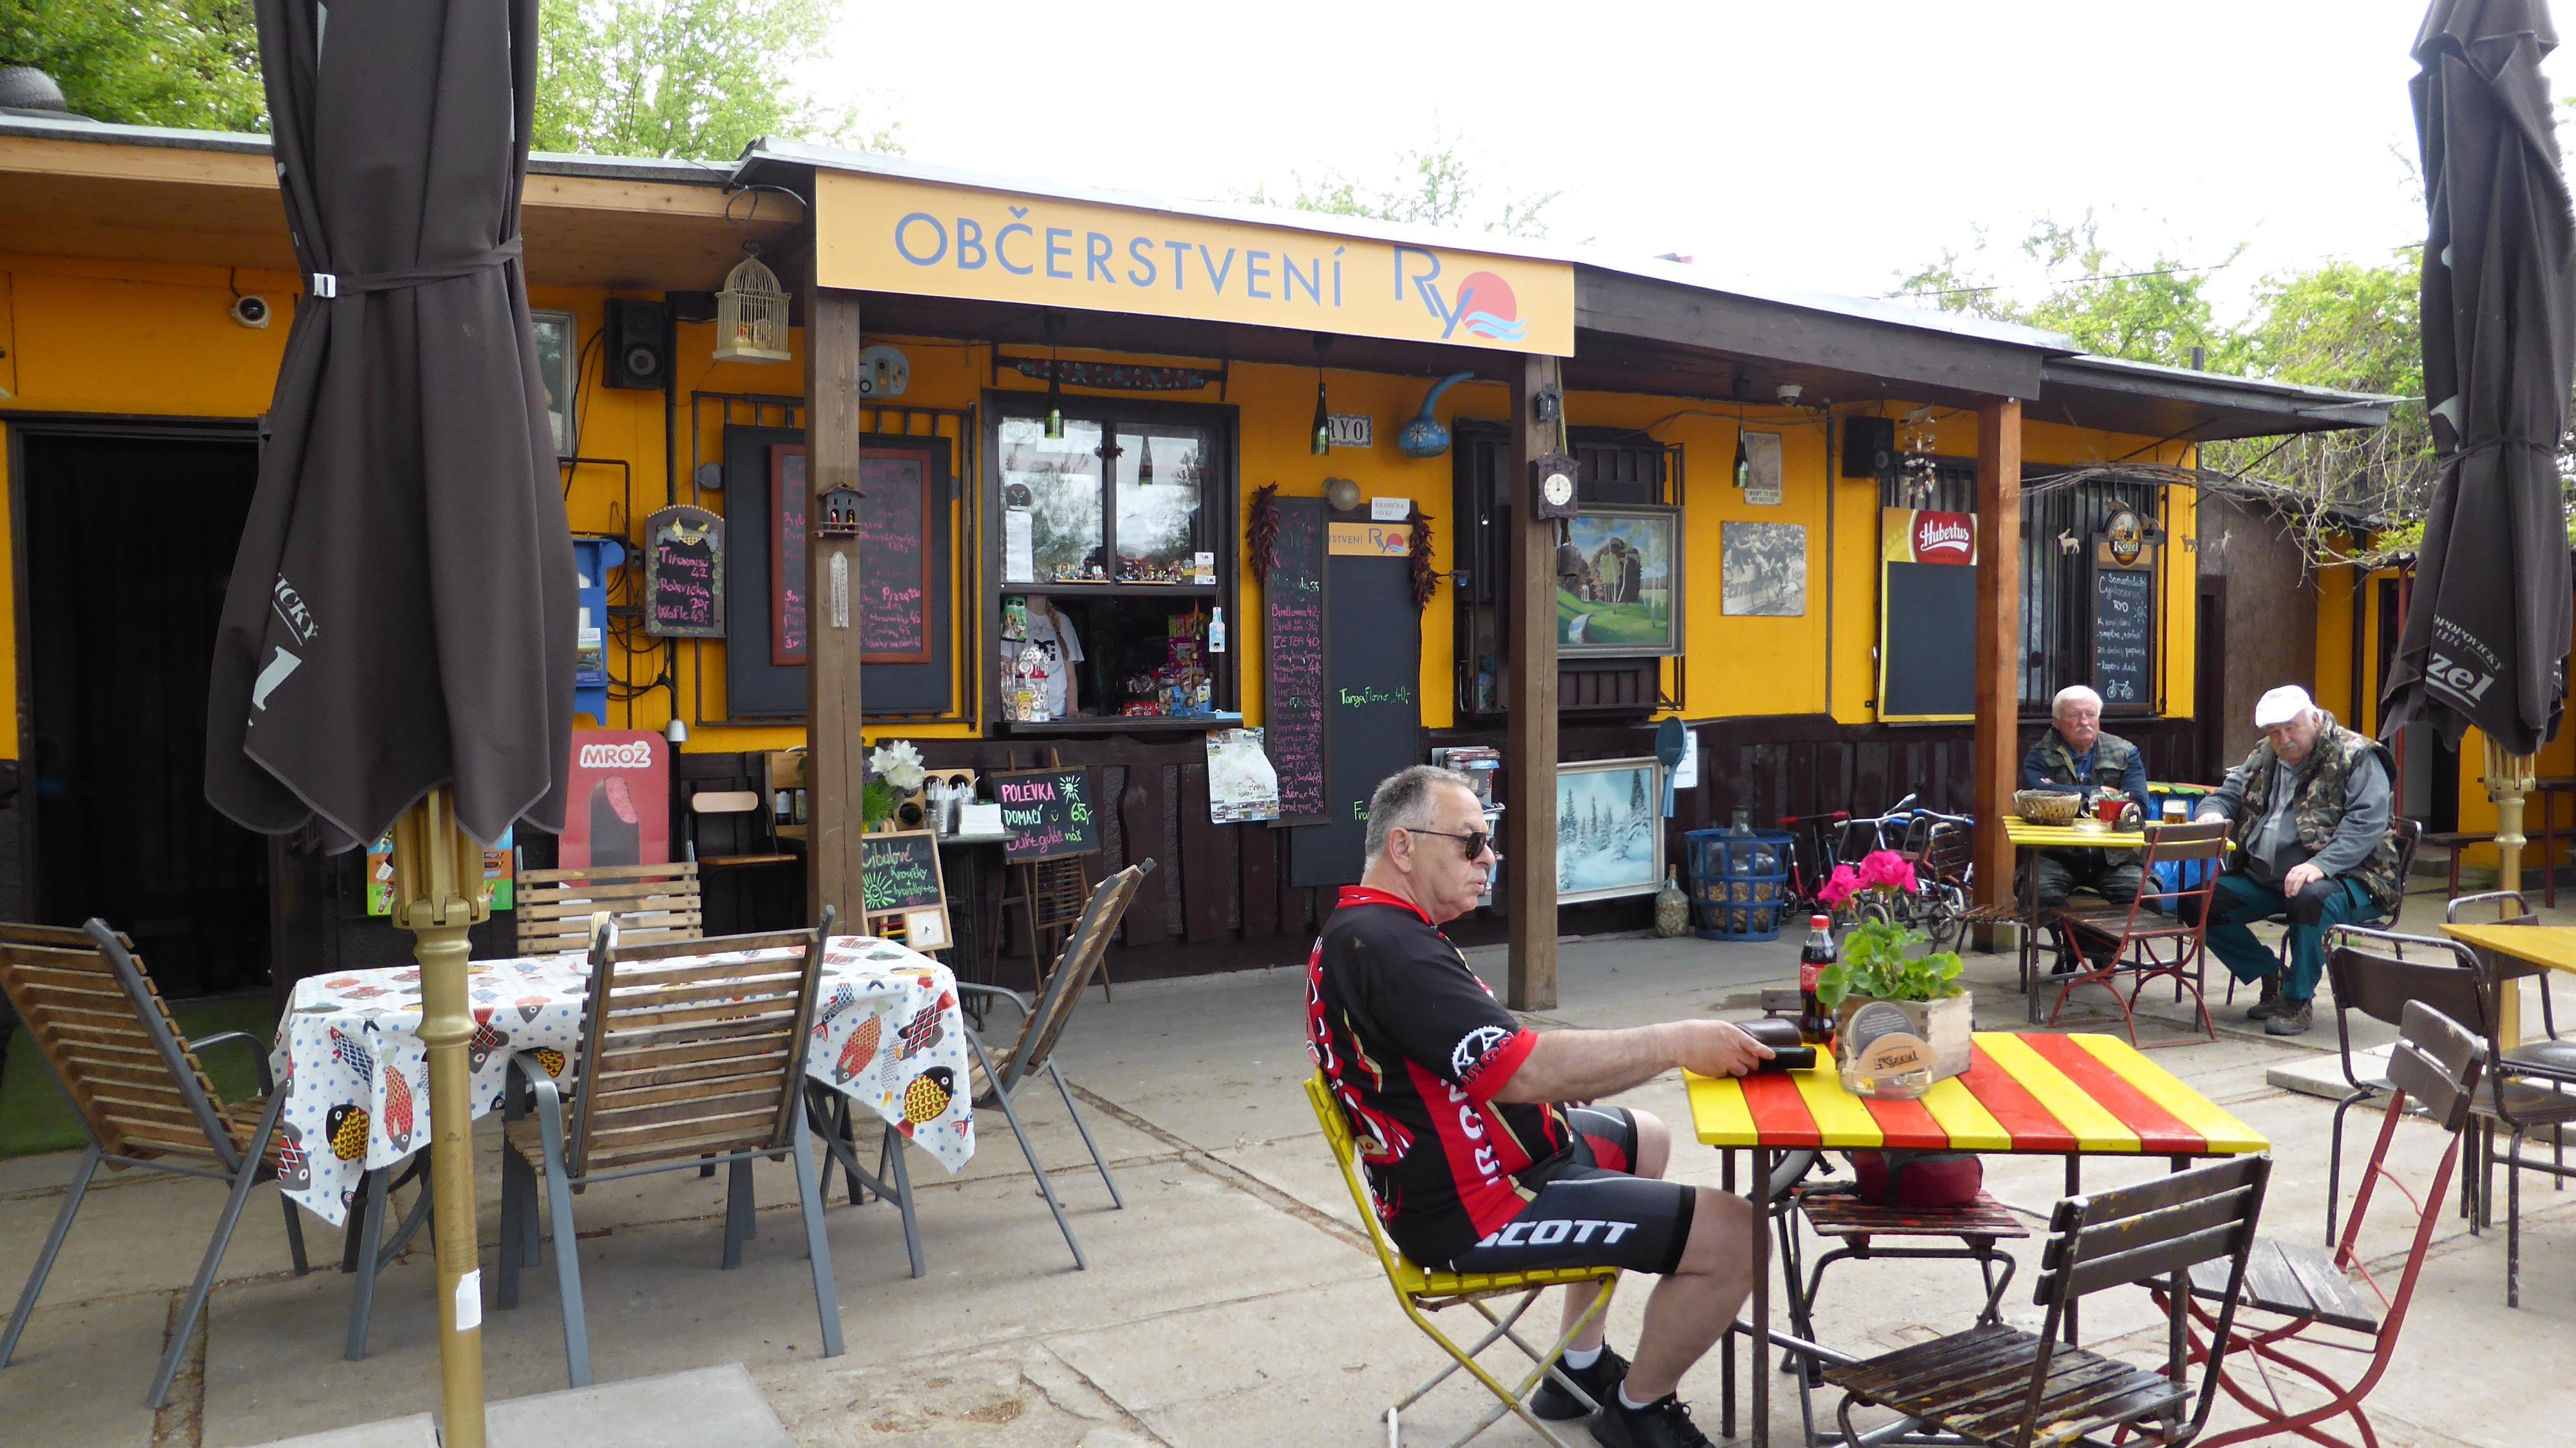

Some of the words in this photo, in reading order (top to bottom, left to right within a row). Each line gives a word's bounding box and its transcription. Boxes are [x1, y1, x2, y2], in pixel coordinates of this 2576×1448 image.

[895, 205, 1344, 308] OBČERSTVENÍ
[1919, 519, 1969, 548] Hubertus
[2113, 540, 2139, 553] Kozel
[2427, 653, 2496, 702] zel
[1340, 688, 1366, 708] Targa
[582, 743, 650, 767] MROŽ
[1001, 779, 1056, 803] POLÉVKA
[1065, 824, 1083, 843] náš
